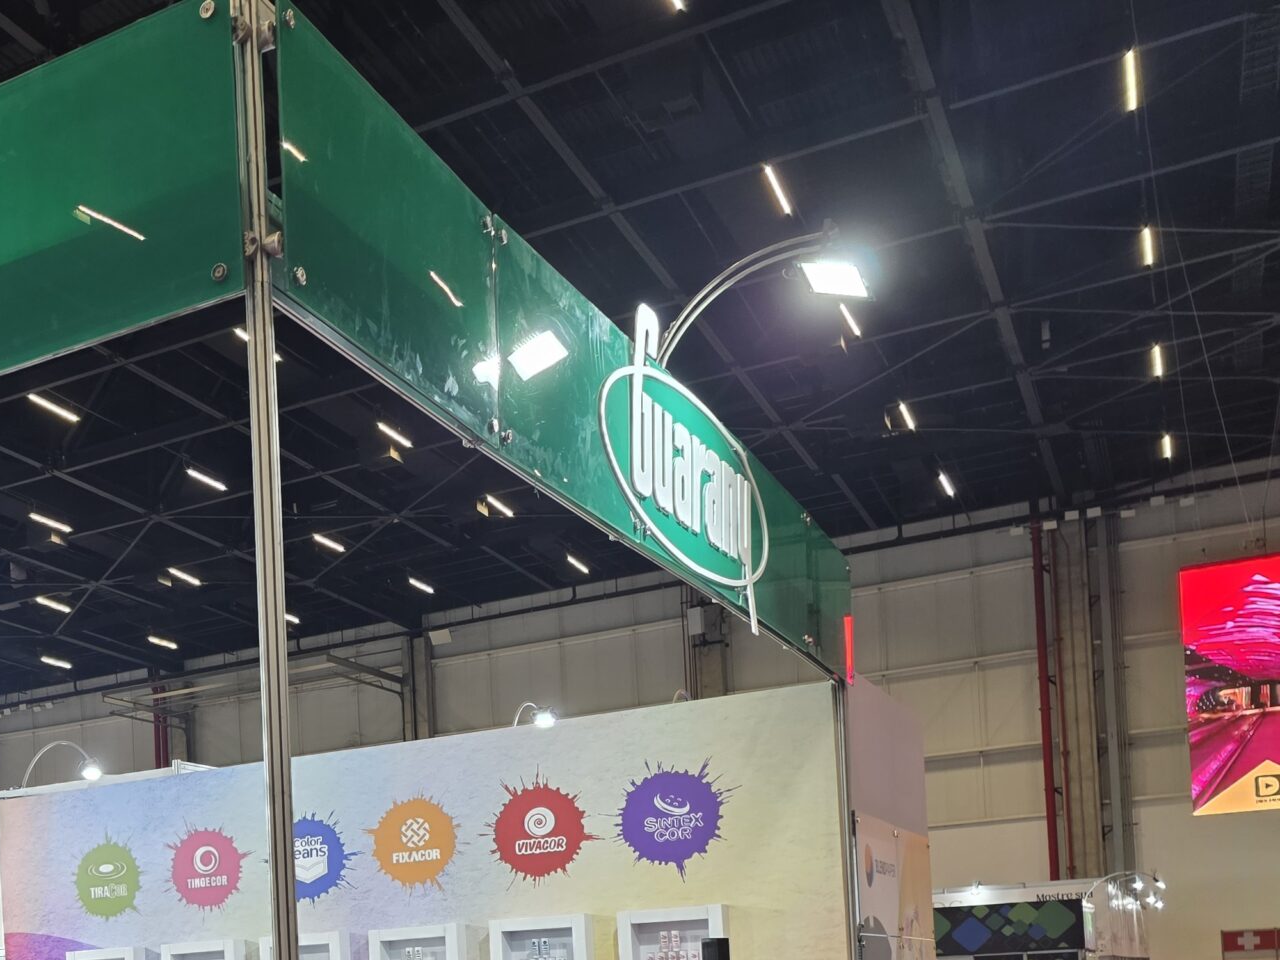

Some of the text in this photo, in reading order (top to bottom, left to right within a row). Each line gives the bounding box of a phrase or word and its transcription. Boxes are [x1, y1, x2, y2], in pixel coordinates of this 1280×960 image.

[644, 813, 704, 833] SINTEX
[654, 827, 692, 842] COR
[293, 846, 327, 859] eans
[517, 836, 566, 854] VIVACOR
[392, 848, 440, 863] FIXACOR
